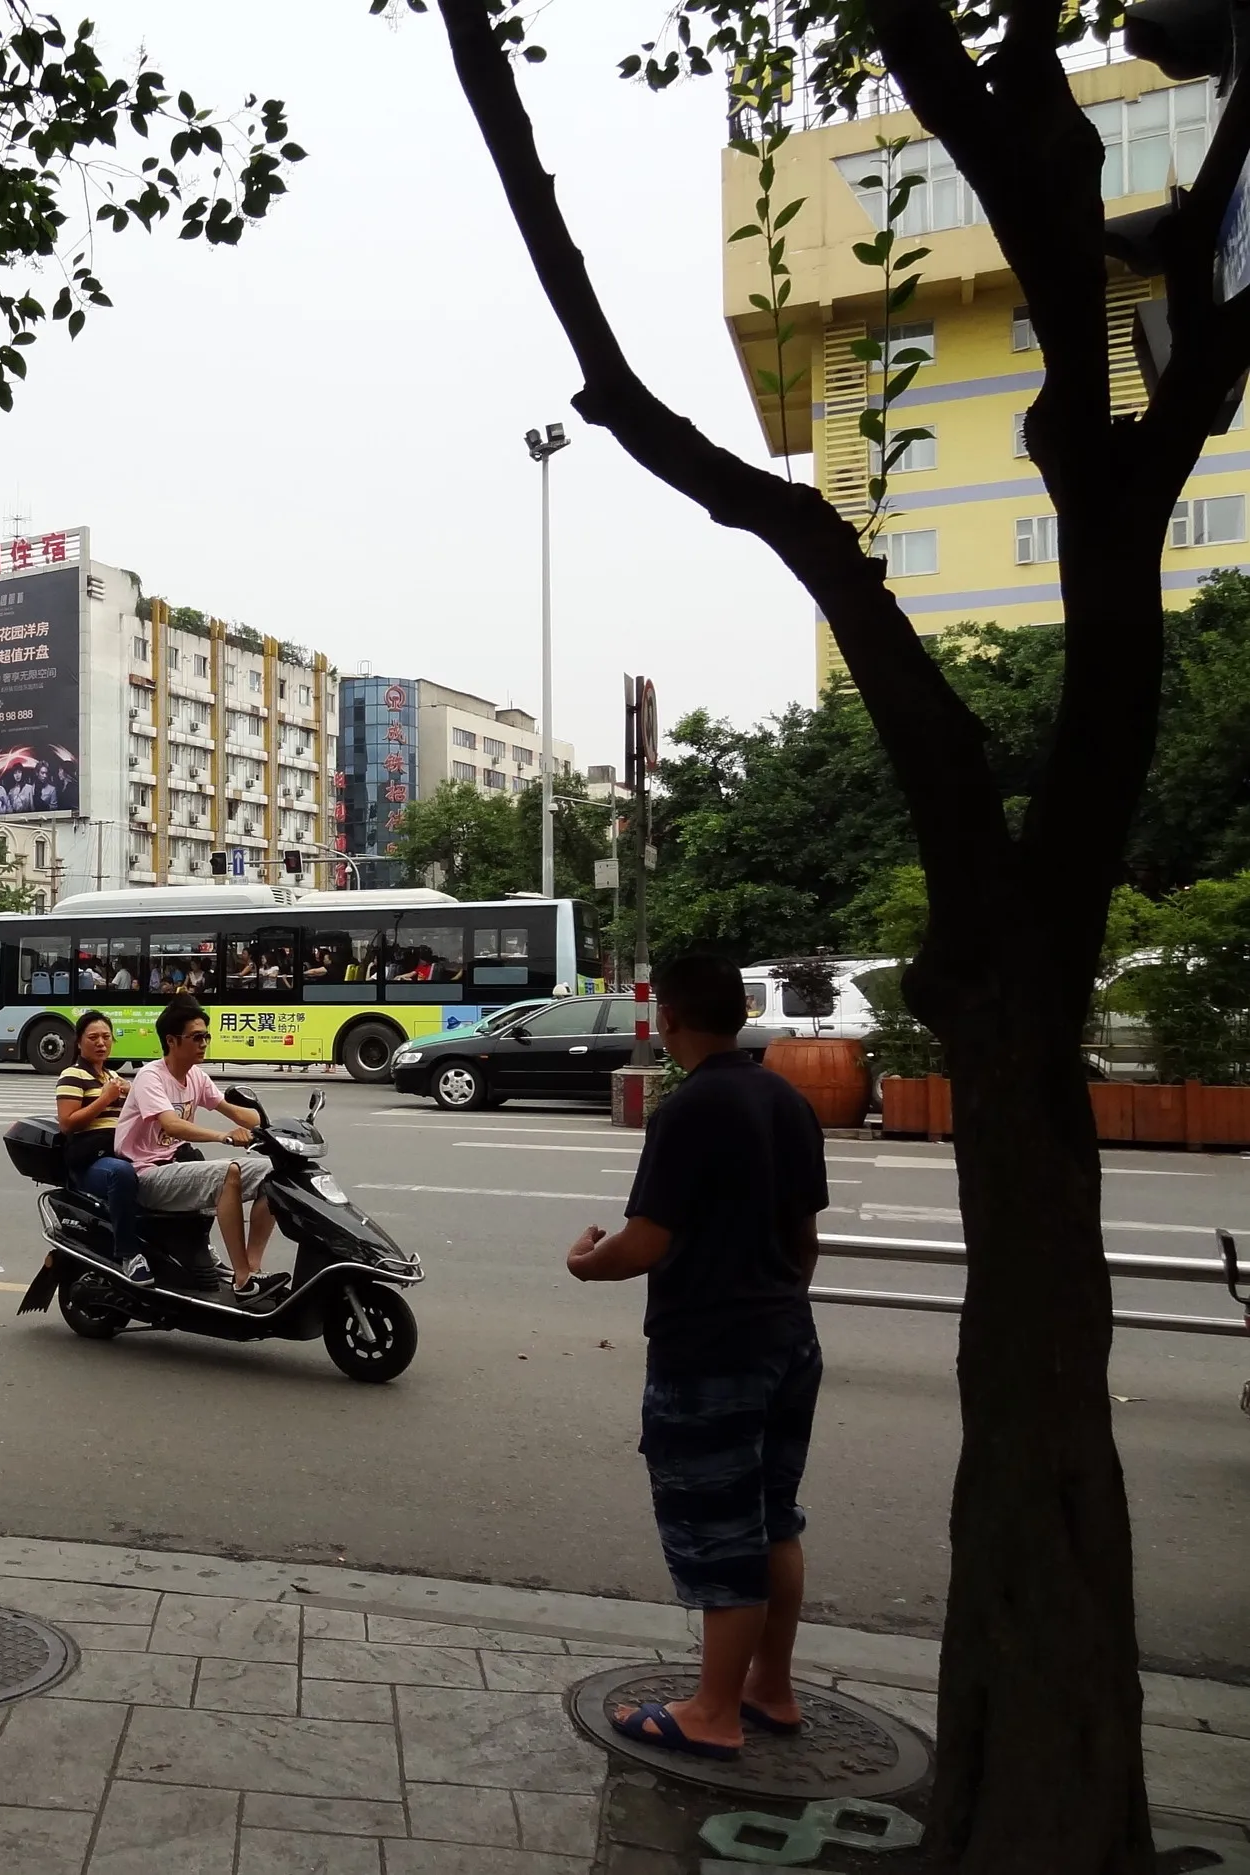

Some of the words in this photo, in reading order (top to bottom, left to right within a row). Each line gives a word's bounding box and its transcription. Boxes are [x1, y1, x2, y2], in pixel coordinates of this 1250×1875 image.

[17, 709, 34, 720] 888
[220, 1013, 276, 1032] 用天翼
[278, 1013, 305, 1023] 这才够
